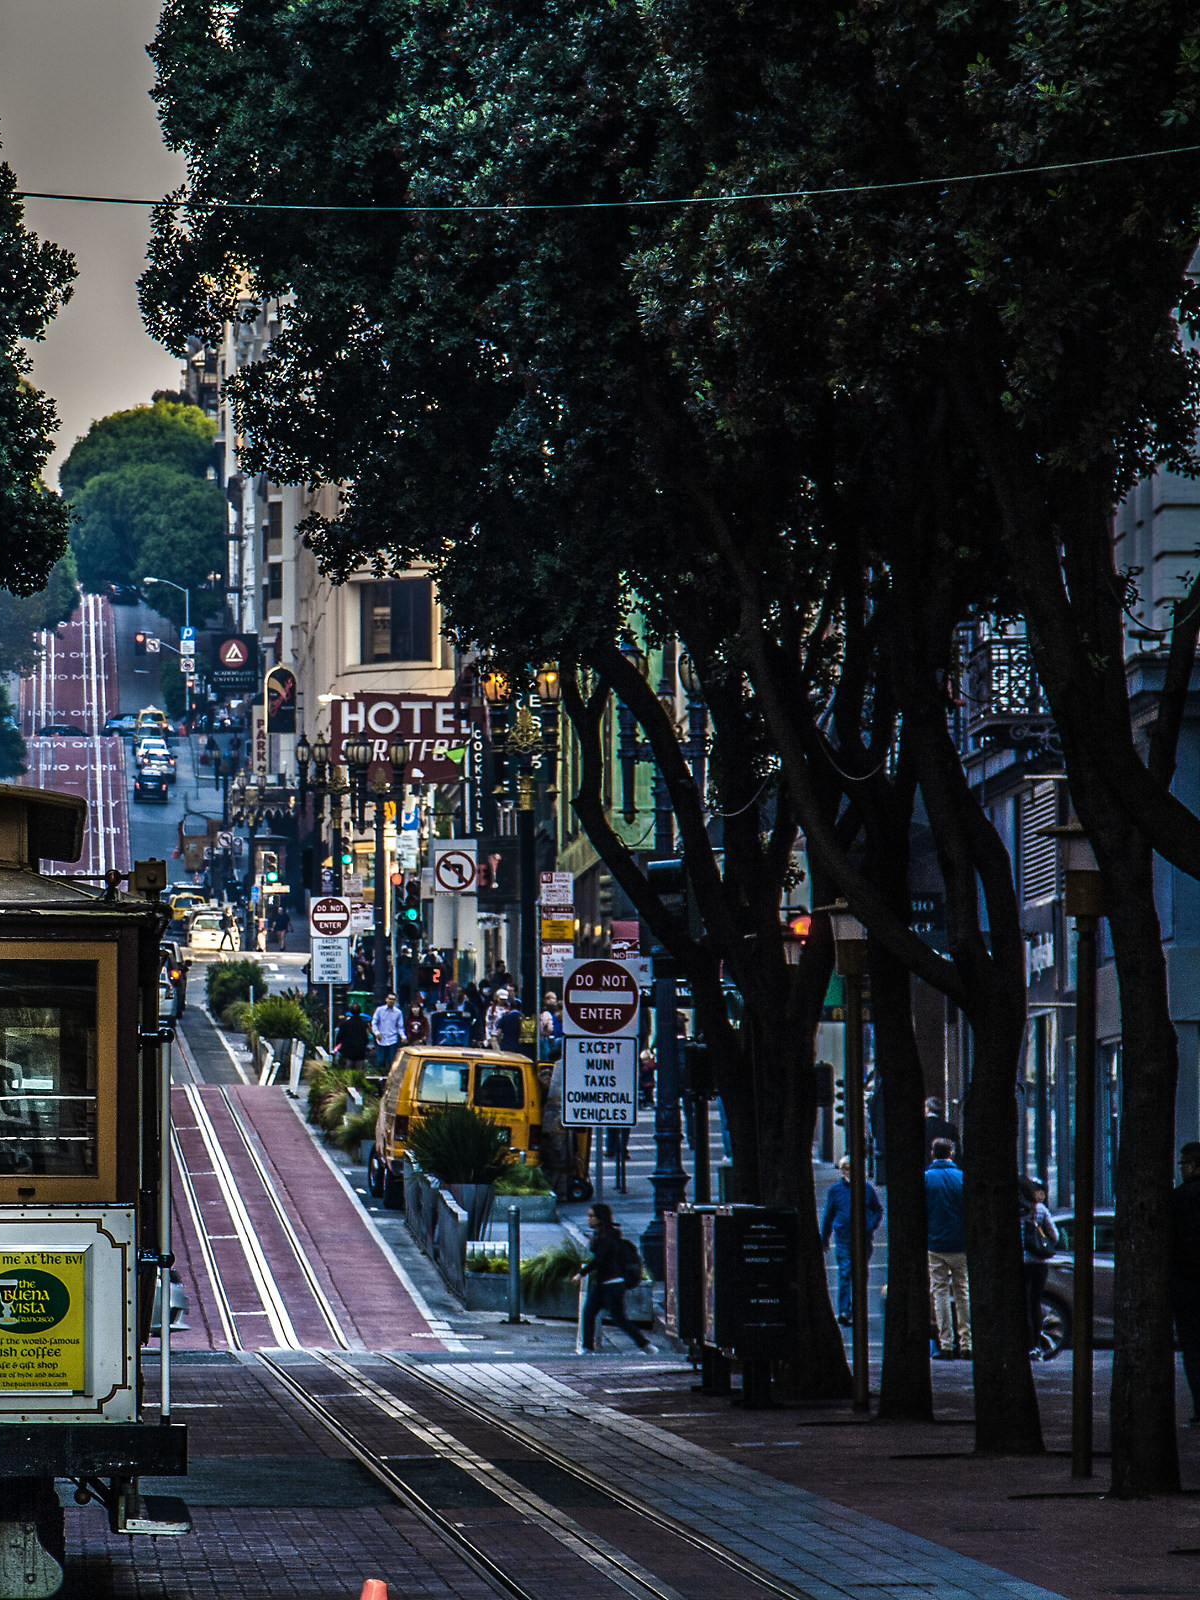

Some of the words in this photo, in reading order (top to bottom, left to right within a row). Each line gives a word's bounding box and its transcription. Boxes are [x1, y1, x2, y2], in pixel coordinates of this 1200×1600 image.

[341, 701, 471, 734] HOTEL
[473, 729, 484, 833] COCKTAILS
[317, 904, 327, 912] DO
[330, 904, 344, 912] NOT
[432, 968, 441, 984] 2
[576, 974, 593, 987] DO
[602, 975, 628, 987] NOT
[580, 1008, 622, 1020] ENTER
[579, 1042, 621, 1053] EXCEPT
[585, 1059, 614, 1070] MUNI
[584, 1075, 616, 1087] TAXIS
[567, 1092, 632, 1103] COMMERCIAL
[573, 1108, 626, 1120] VEHICLES
